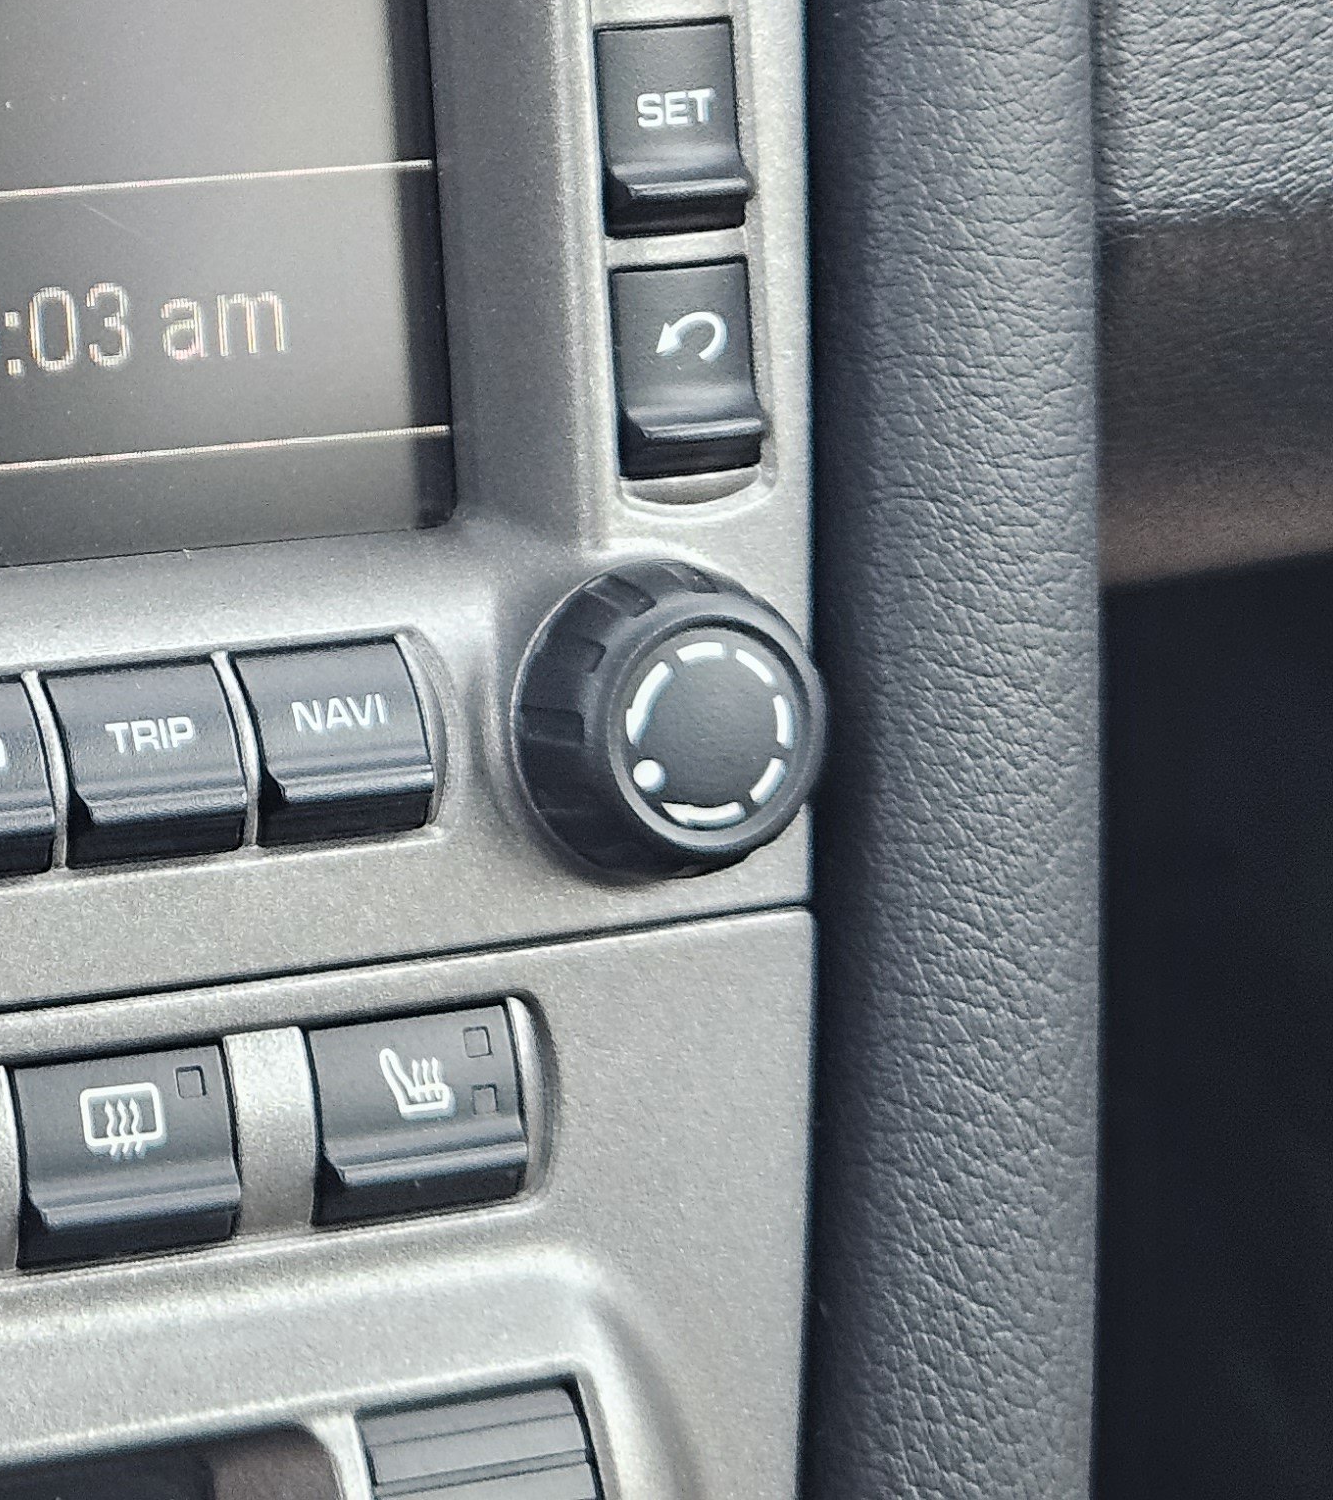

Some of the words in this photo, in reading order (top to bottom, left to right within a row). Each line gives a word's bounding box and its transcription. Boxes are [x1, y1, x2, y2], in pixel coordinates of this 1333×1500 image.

[636, 87, 717, 129] SET
[160, 288, 290, 362] am
[290, 692, 387, 735] NAVI
[104, 714, 196, 756] TRIP
